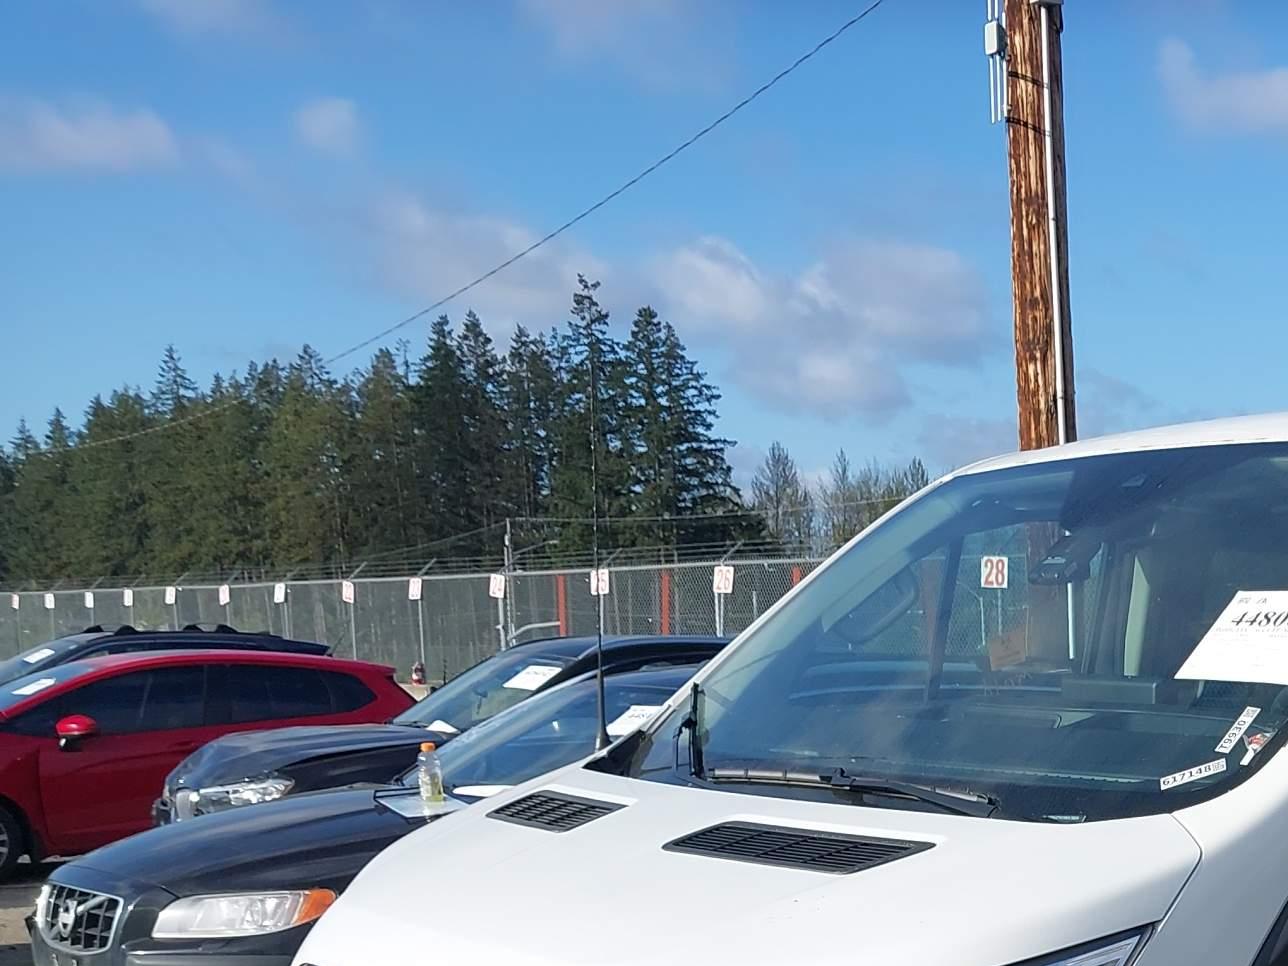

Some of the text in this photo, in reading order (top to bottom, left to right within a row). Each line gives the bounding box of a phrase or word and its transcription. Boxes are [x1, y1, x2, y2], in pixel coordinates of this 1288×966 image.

[715, 569, 731, 591] 26
[984, 558, 1006, 586] 28
[1219, 719, 1247, 750] T9930
